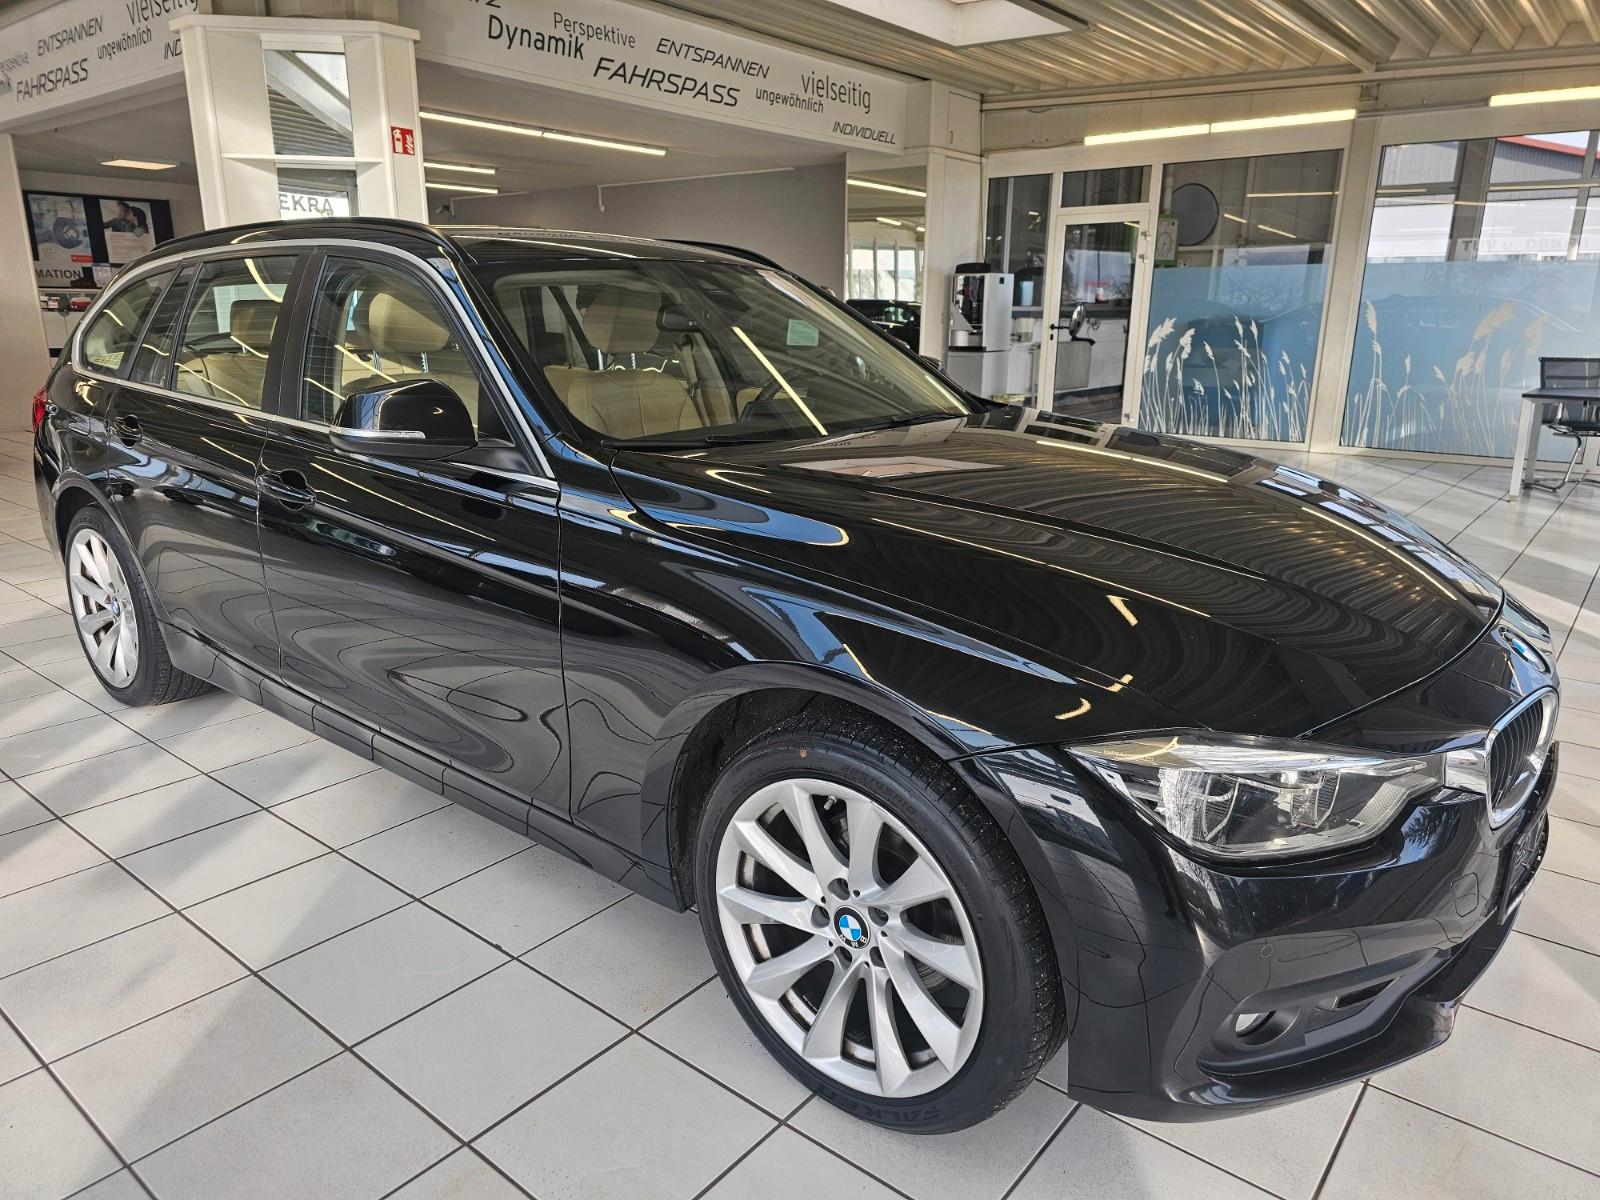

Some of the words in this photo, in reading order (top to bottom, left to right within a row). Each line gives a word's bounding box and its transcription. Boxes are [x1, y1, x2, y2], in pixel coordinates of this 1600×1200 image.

[37, 14, 103, 57] ENTSPANNEN
[97, 25, 153, 61] ungewöhnlich
[488, 14, 585, 61] Dynamik
[553, 11, 636, 49] Perspektive
[656, 37, 770, 79] ENTSPANNEN
[16, 58, 89, 103] FAHRSPASS
[593, 57, 741, 107] FAHRSPASS
[755, 86, 824, 114] ungewöhnlich
[801, 70, 872, 115] vielseitig
[832, 121, 896, 145] INDIVIDUELL
